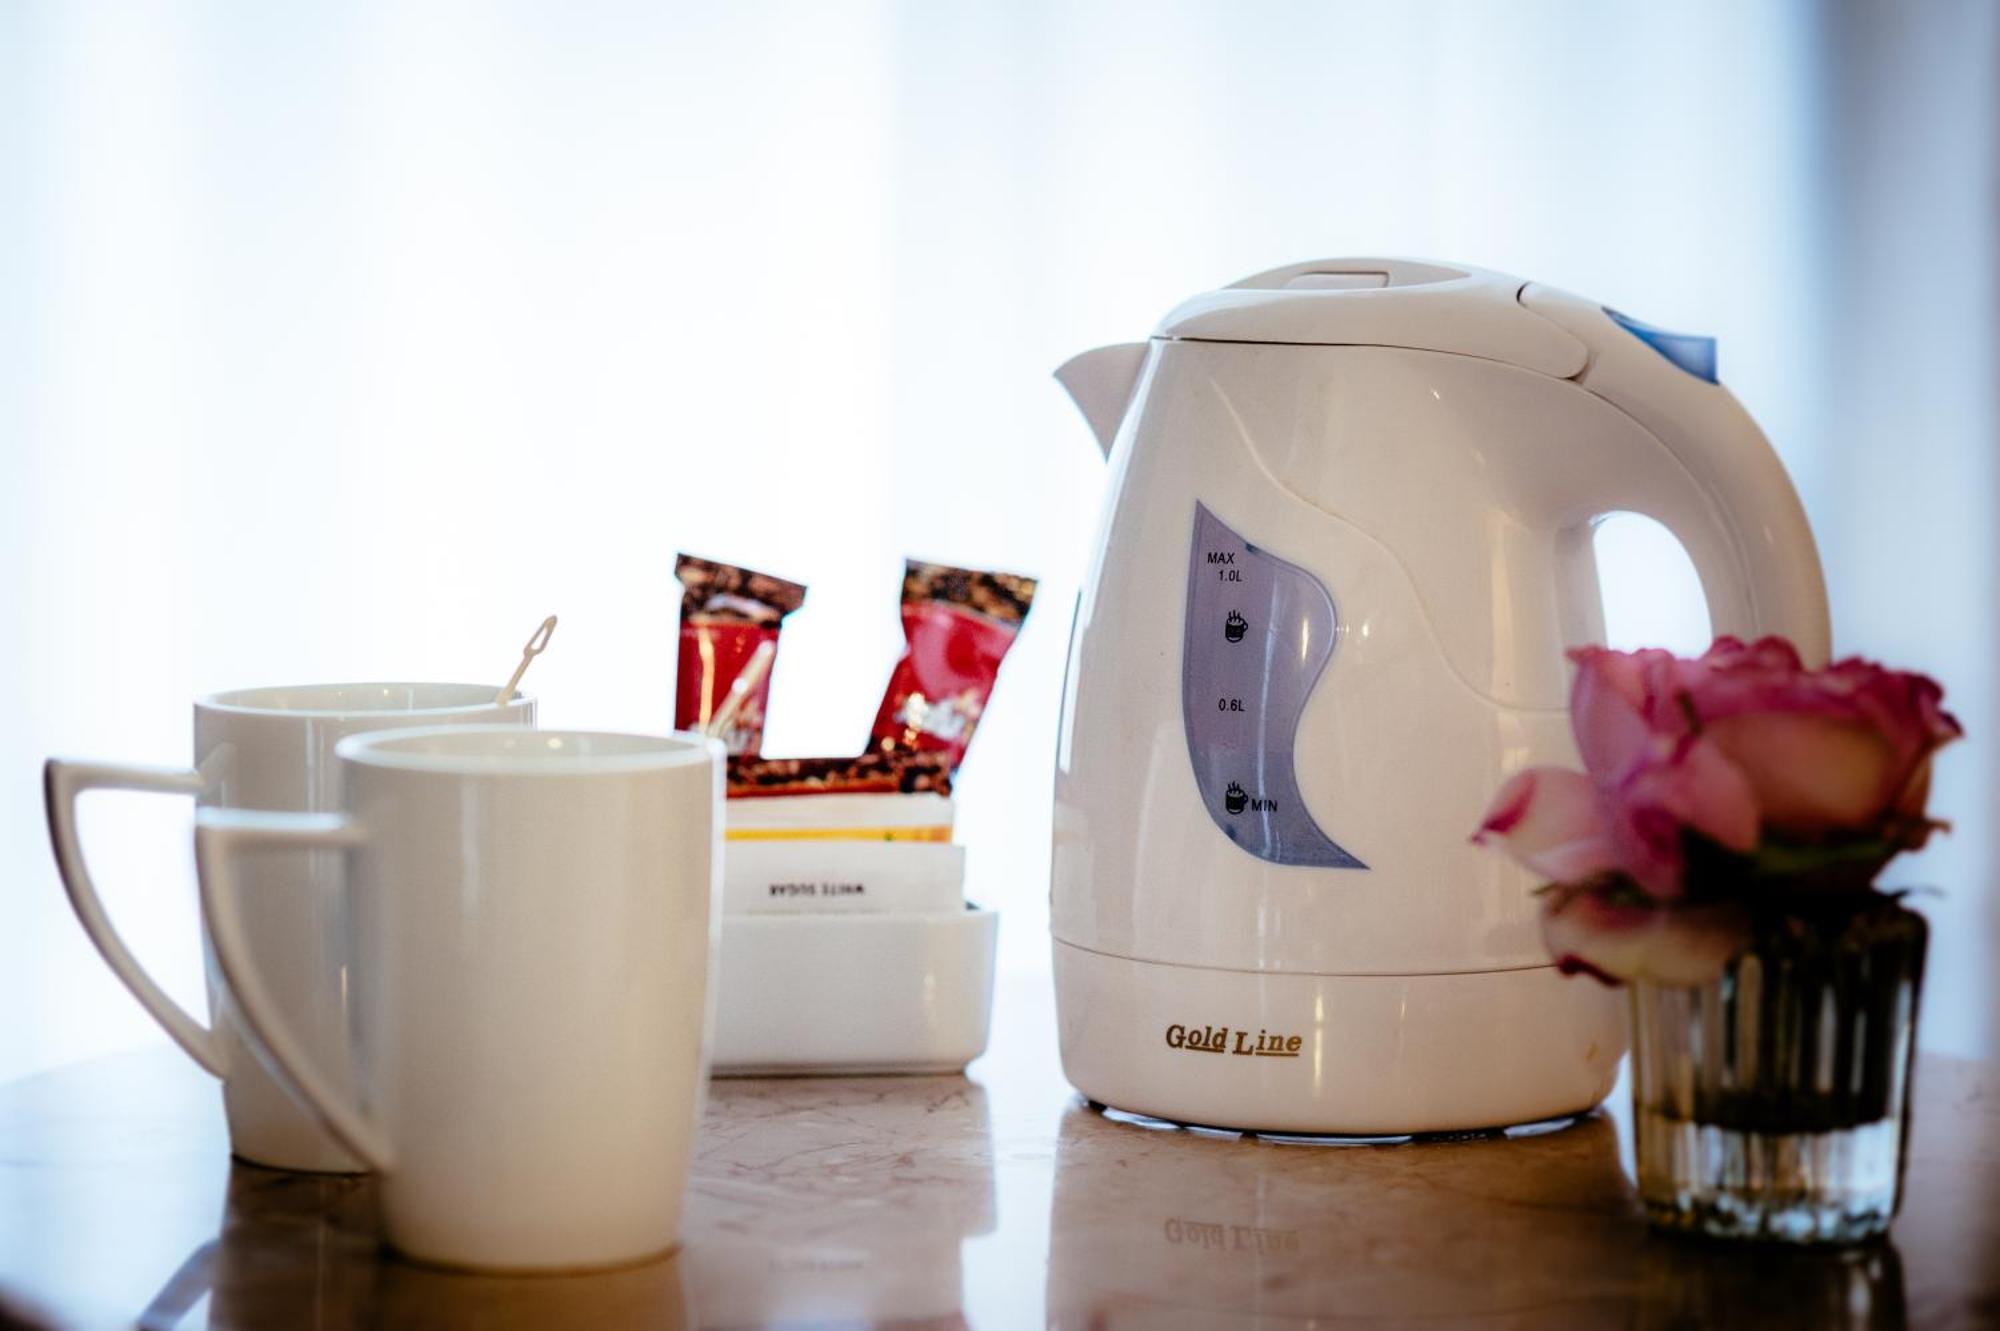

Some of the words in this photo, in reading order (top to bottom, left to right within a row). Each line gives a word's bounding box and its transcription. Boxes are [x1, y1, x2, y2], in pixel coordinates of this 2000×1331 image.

[1207, 552, 1235, 565] MAX
[1219, 570, 1242, 582] 1.0L
[1219, 698, 1245, 712] 0.6L
[1251, 798, 1278, 812] MIN
[768, 883, 815, 897] SUGAR
[822, 883, 865, 896] WHITE
[1166, 1024, 1228, 1053] Gold
[1232, 1029, 1302, 1056] Line
